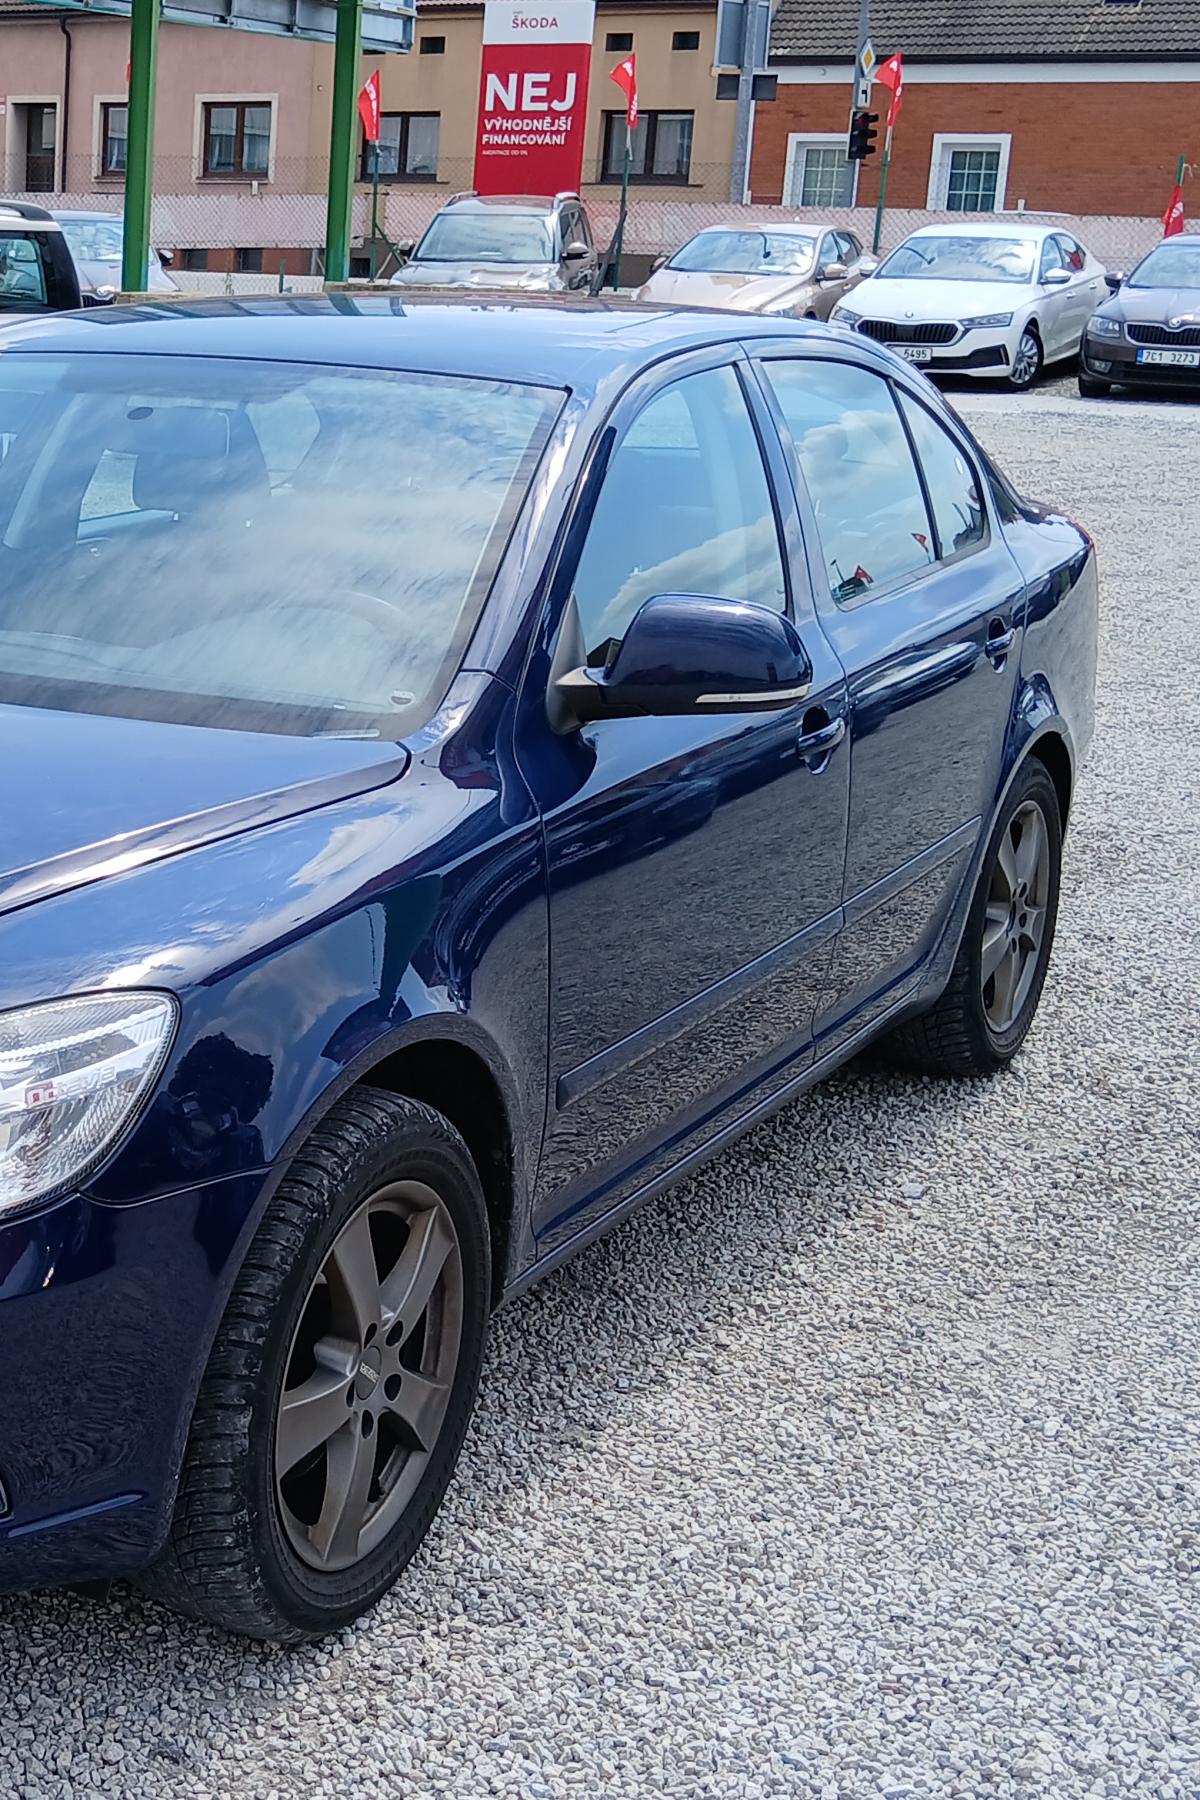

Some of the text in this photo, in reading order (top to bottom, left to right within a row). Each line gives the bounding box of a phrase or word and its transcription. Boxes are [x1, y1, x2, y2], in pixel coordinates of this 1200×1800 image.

[511, 14, 559, 29] ŠKODA
[484, 72, 577, 112] NEJ
[484, 116, 573, 131] VÝHODNĚJŠÍ
[481, 132, 566, 145] FINANCOVÁNÍ
[1144, 351, 1163, 362] 7C1
